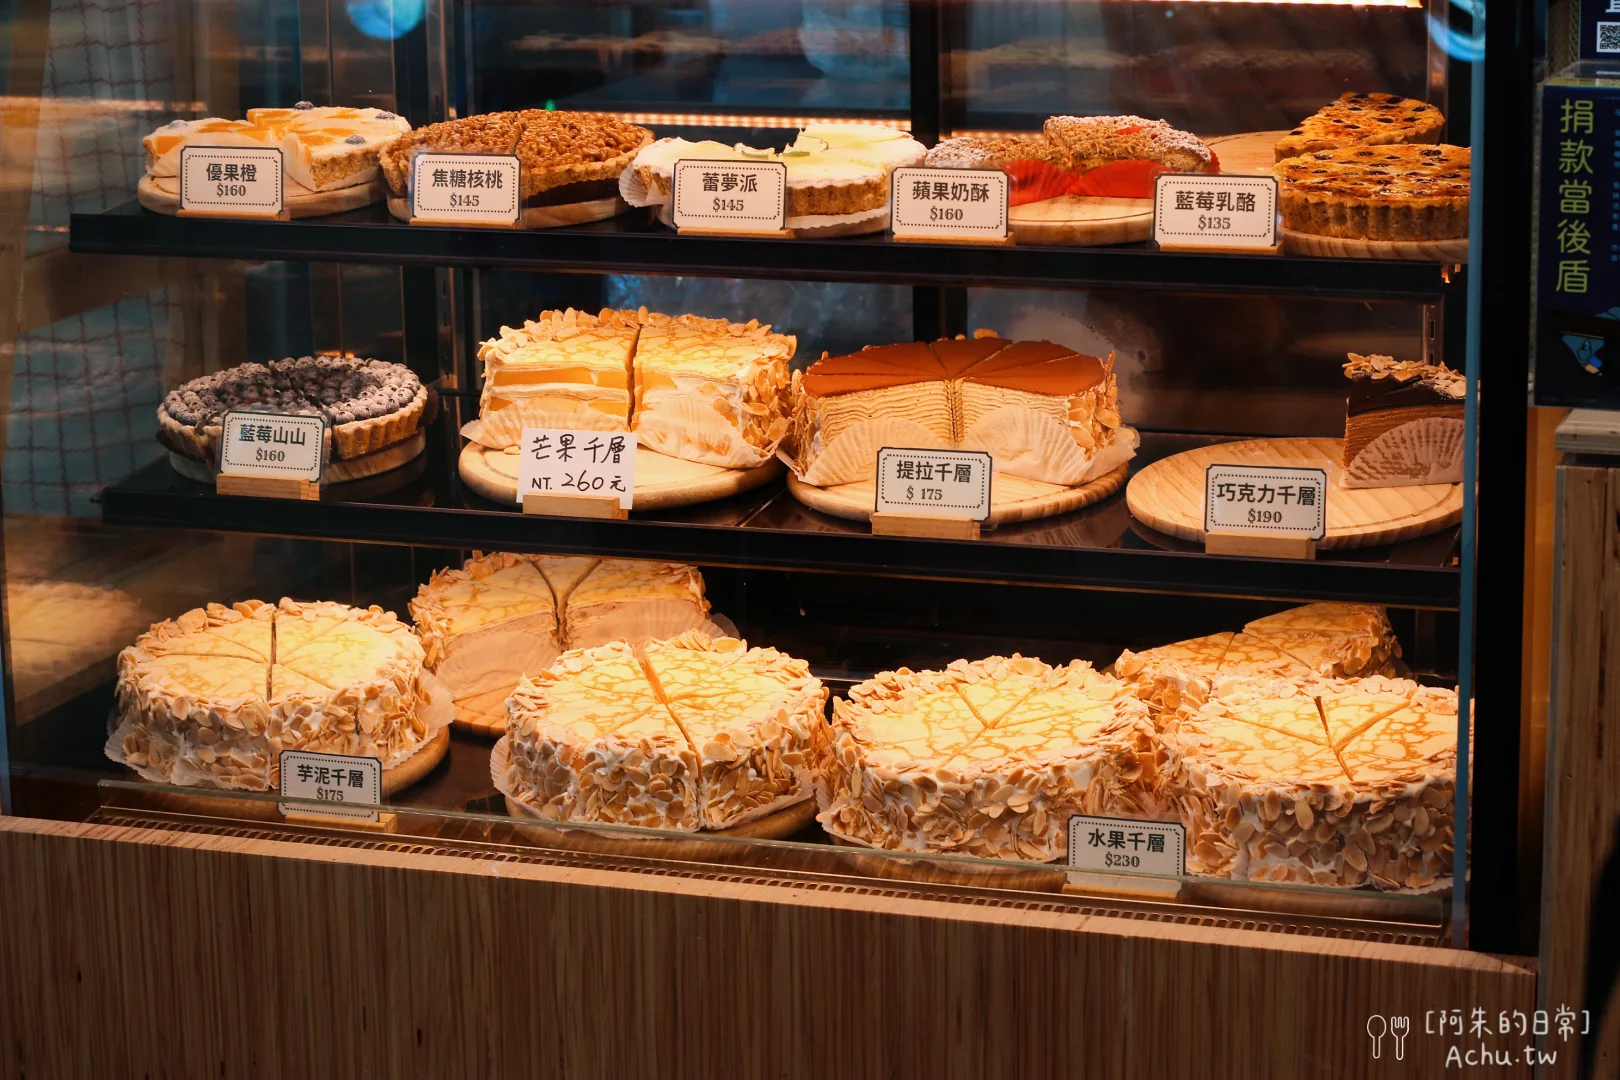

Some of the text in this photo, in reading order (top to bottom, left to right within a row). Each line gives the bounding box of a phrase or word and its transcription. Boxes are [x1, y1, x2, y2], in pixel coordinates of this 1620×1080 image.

[206, 162, 257, 183] 優果橙
[432, 168, 503, 190] 焦糖核桃
[702, 172, 758, 193] 蕾夢派
[217, 183, 246, 197] $160
[450, 193, 479, 207] $145
[912, 181, 989, 203] 蘋果奶酥
[1556, 99, 1594, 293] 捐款當後盾
[713, 197, 744, 212] $145
[1175, 190, 1256, 213] 藍莓乳酪
[930, 206, 964, 221] $160
[1198, 215, 1231, 230] $135
[239, 424, 306, 446] 藍莓山山
[256, 448, 285, 462] $160
[531, 434, 627, 464] 芒果千層
[896, 461, 971, 483] 提拉千層
[531, 477, 553, 491] NT.
[1216, 482, 1316, 506] 巧克力千層
[1248, 508, 1282, 524] $190
[297, 764, 364, 788] 芋泥千層
[316, 787, 344, 801] $175
[1087, 829, 1165, 853] 水果千層
[1105, 852, 1140, 868] $230
